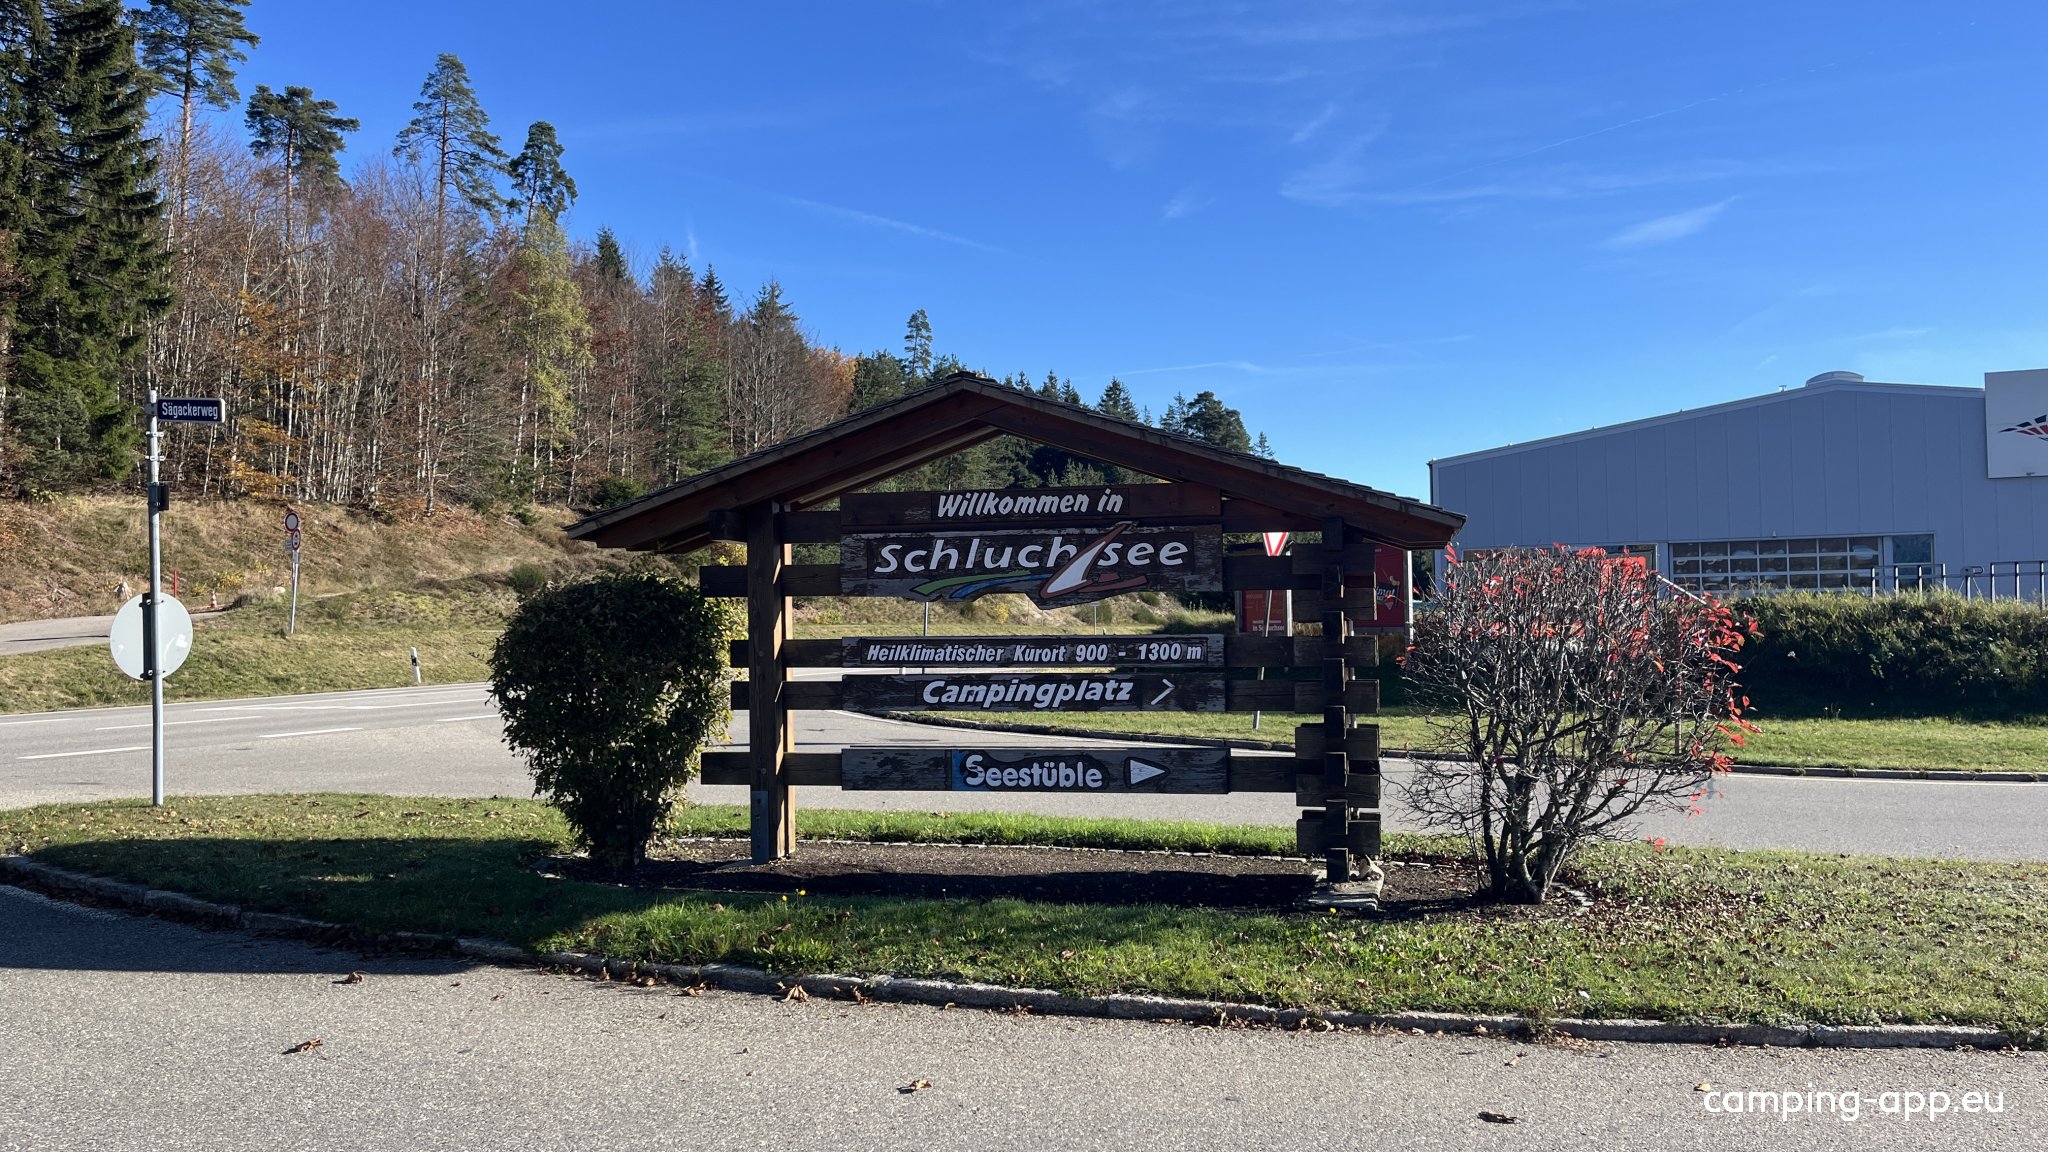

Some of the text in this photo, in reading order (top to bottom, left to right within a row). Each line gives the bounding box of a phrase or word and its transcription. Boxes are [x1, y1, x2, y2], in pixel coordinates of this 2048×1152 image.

[161, 402, 218, 420] Sägackerweg
[937, 488, 1123, 518] Willkommen in
[874, 536, 1188, 573] Schluchsee
[867, 644, 1004, 662] Heilklimatischer
[1013, 645, 1066, 662] Kurort
[1075, 644, 1108, 662] 900
[1138, 643, 1182, 661] 1300
[1186, 645, 1202, 660] m
[922, 678, 1133, 709] Campingplatz
[965, 754, 1103, 788] Seestüble
